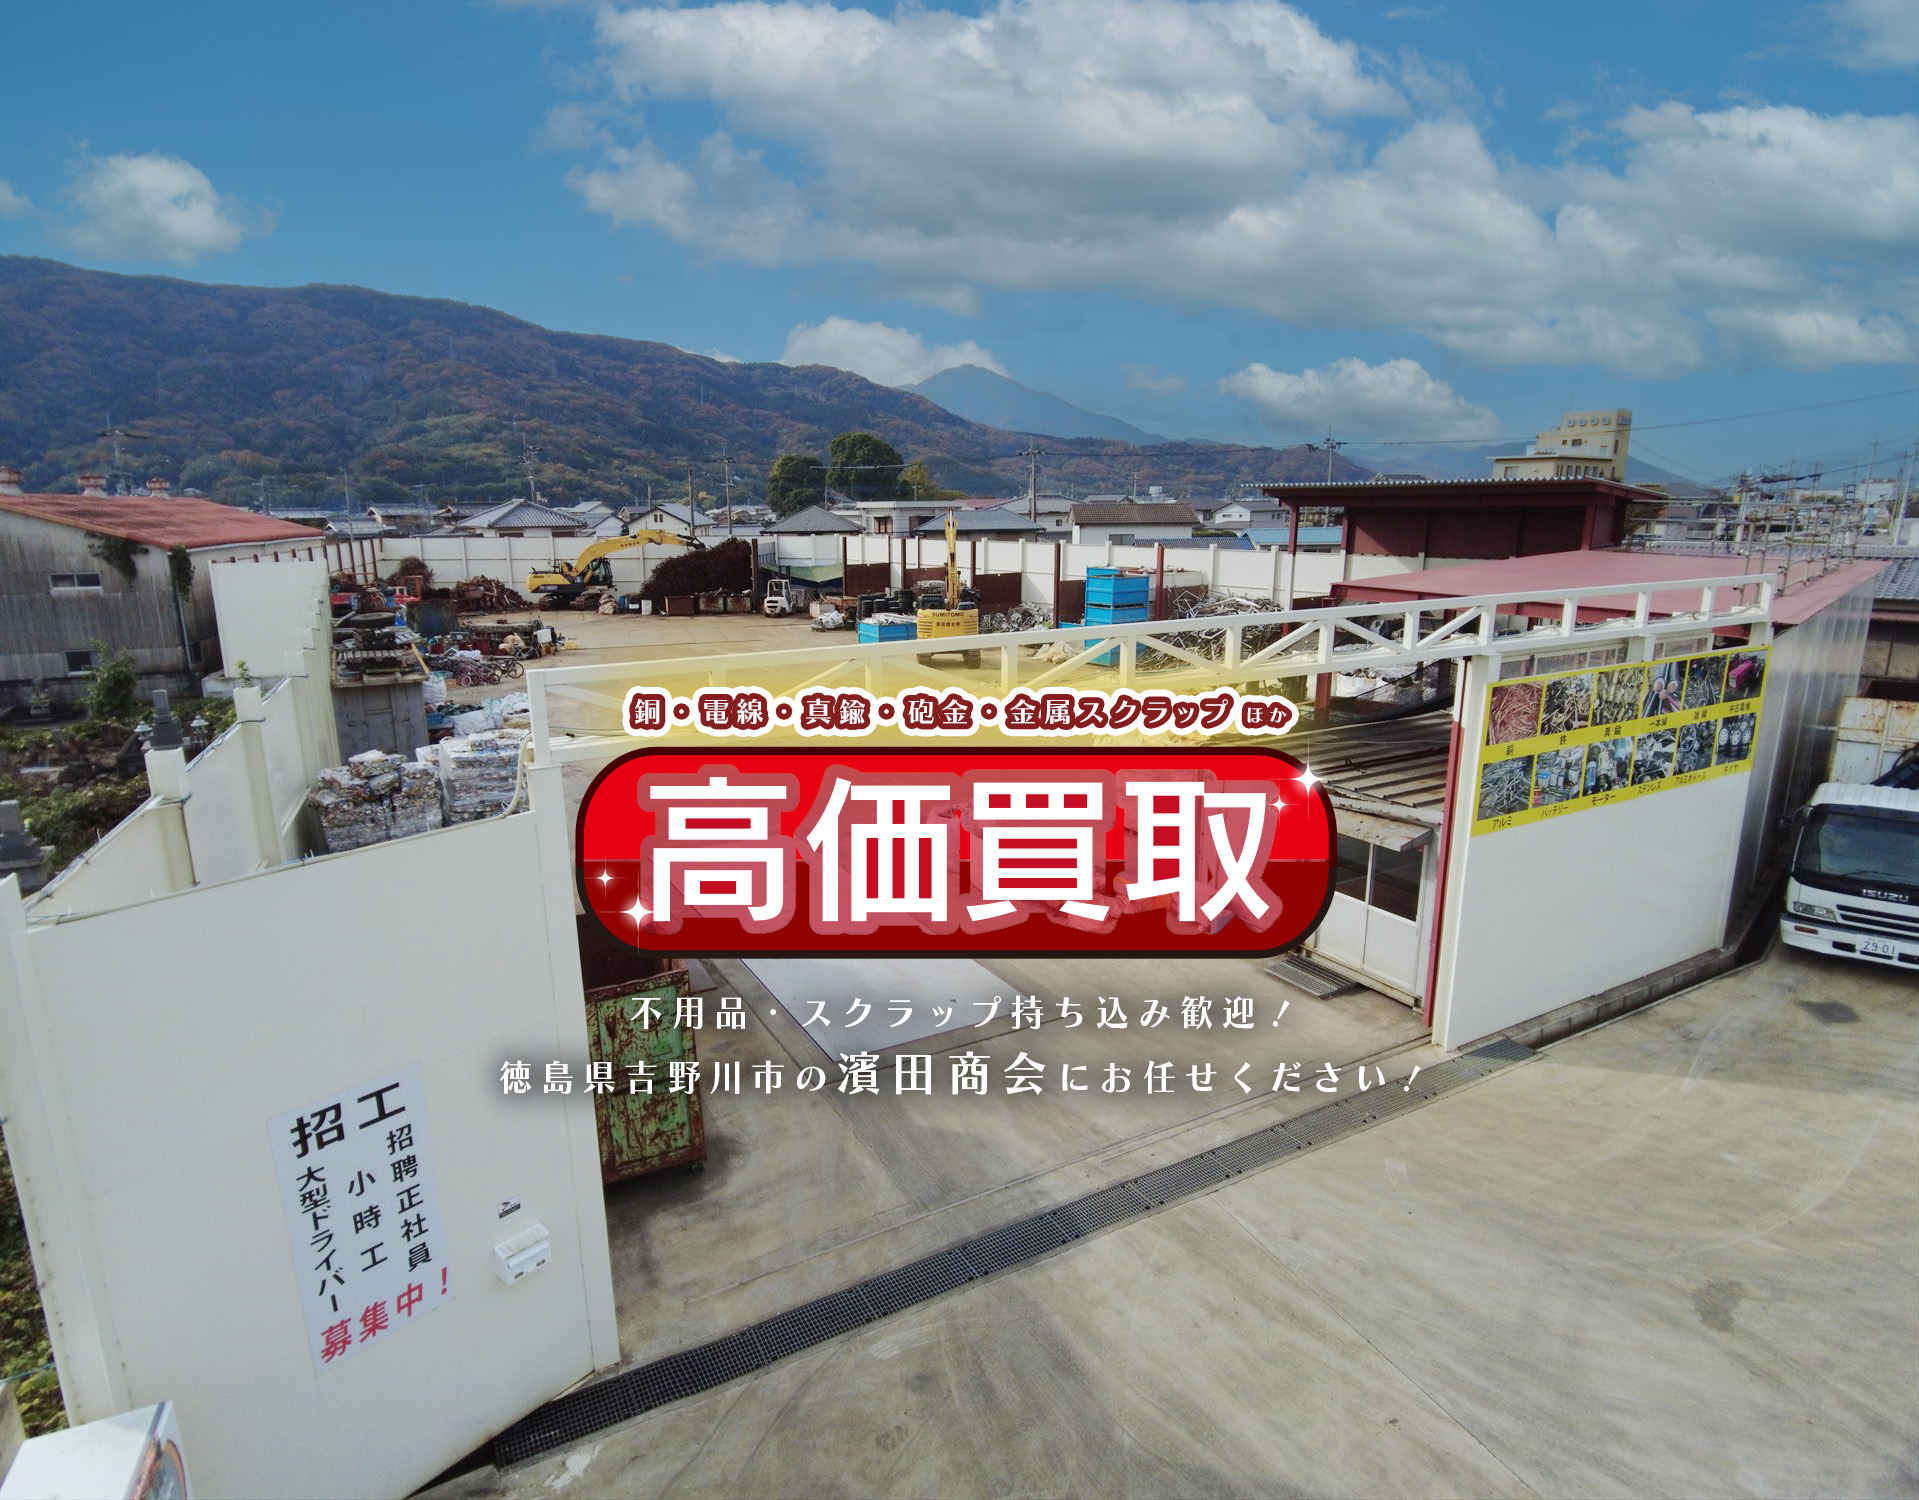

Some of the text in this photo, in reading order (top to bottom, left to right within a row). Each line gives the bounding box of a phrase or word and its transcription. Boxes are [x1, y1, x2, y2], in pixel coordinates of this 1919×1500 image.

[1492, 816, 1512, 829] アルミ
[1541, 805, 1568, 817] バッテリー
[1592, 794, 1616, 805] モーター
[1863, 888, 1909, 903] ISUZU
[290, 1081, 406, 1159] 招工
[348, 1170, 388, 1272] 小時工
[386, 1123, 433, 1272] 招聘正社員
[296, 1166, 345, 1313] 大型ドライバー
[321, 1266, 448, 1364] 募集中！
